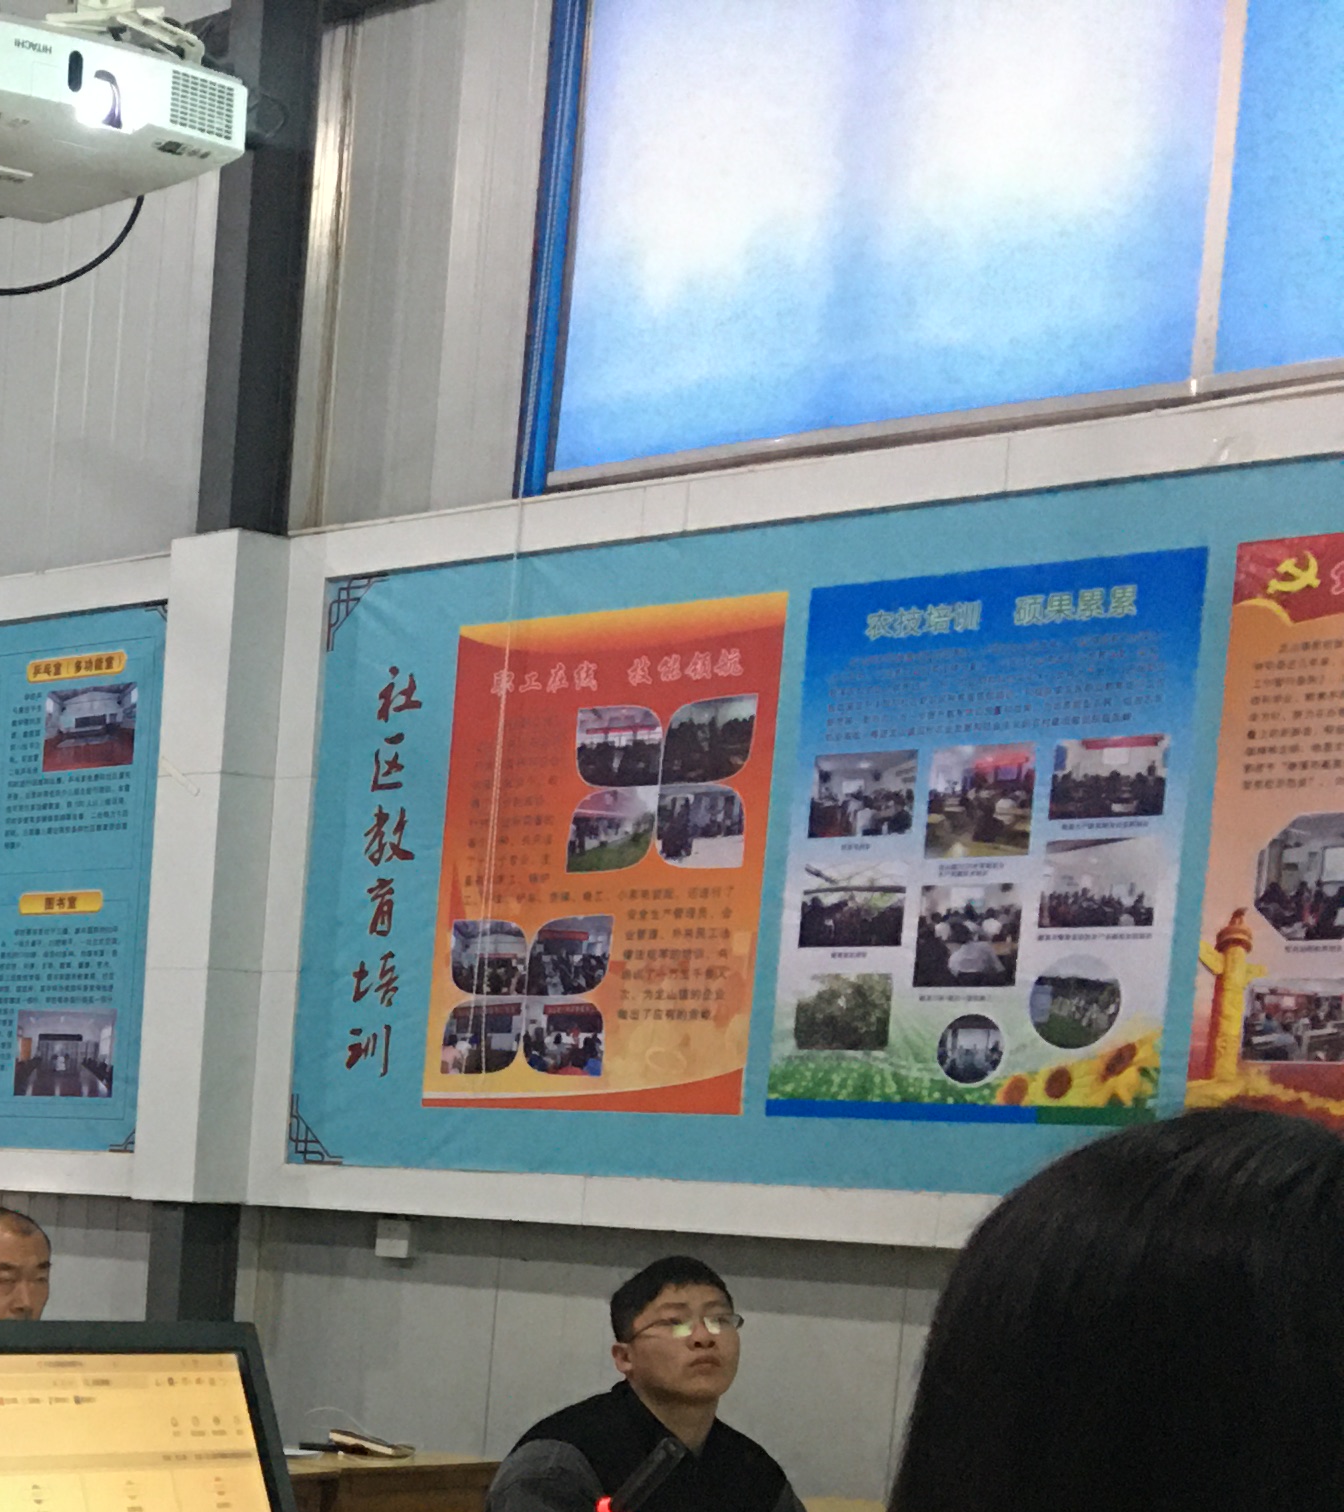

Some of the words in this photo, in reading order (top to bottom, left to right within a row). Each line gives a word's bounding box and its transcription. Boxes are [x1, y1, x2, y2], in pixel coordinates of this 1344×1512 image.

[14, 38, 53, 54] HITACHI
[864, 600, 982, 641] 农技培训
[1014, 584, 1138, 627] 硕果累累
[490, 660, 600, 697] 职工在线
[626, 648, 744, 687] 技能领航
[344, 665, 423, 1078] 社区教育培训
[43, 894, 78, 911] 图书室
